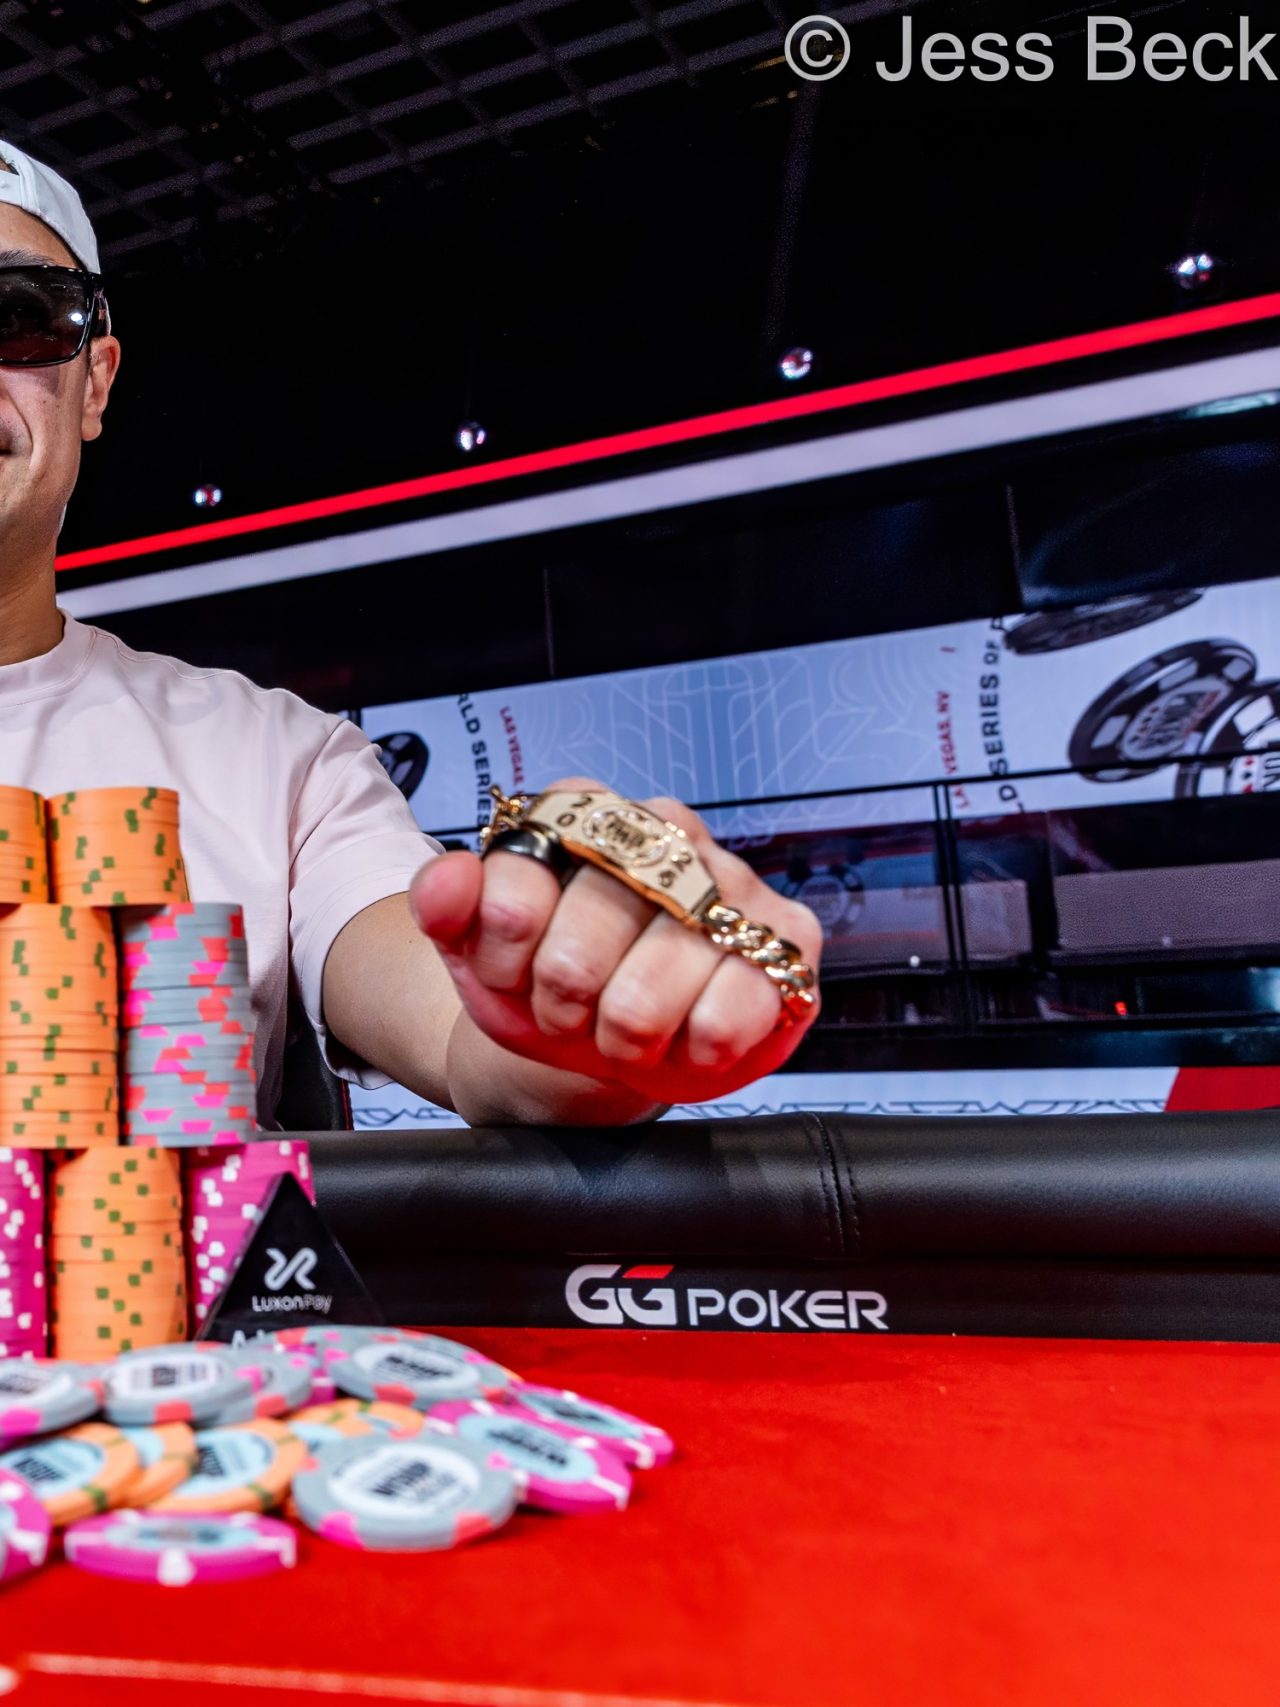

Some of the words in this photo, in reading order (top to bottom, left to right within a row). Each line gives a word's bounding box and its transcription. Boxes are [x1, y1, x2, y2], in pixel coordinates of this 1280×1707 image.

[499, 705, 517, 734] LAS
[979, 672, 1009, 778] SERIES
[471, 738, 492, 829] SERIES
[565, 1264, 677, 1326] GG
[687, 1288, 890, 1331] POKER
